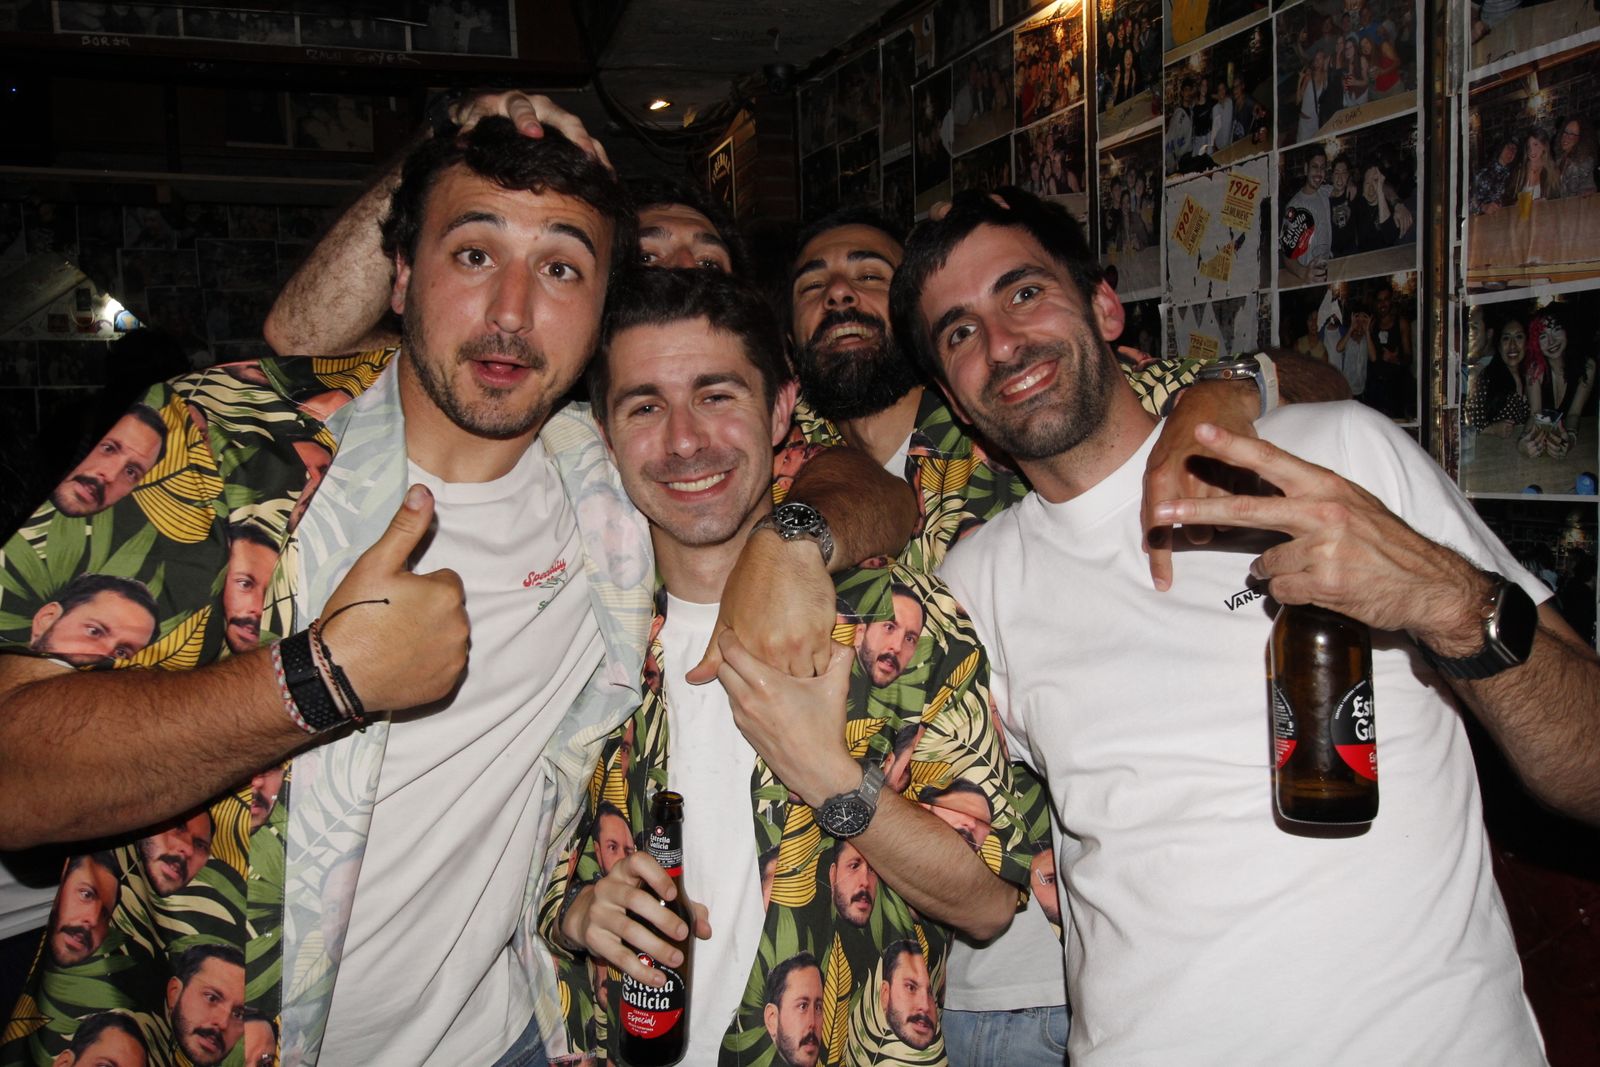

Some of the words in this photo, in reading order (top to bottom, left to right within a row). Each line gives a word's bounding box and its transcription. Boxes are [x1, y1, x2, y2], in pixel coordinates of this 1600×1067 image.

[1229, 180, 1258, 200] 1906
[1175, 199, 1194, 242] 1906
[1223, 587, 1262, 611] VANS
[649, 840, 670, 850] Galicia
[650, 833, 671, 844] Estrella
[622, 984, 670, 1010] Galicia
[627, 1012, 656, 1027] Especial
